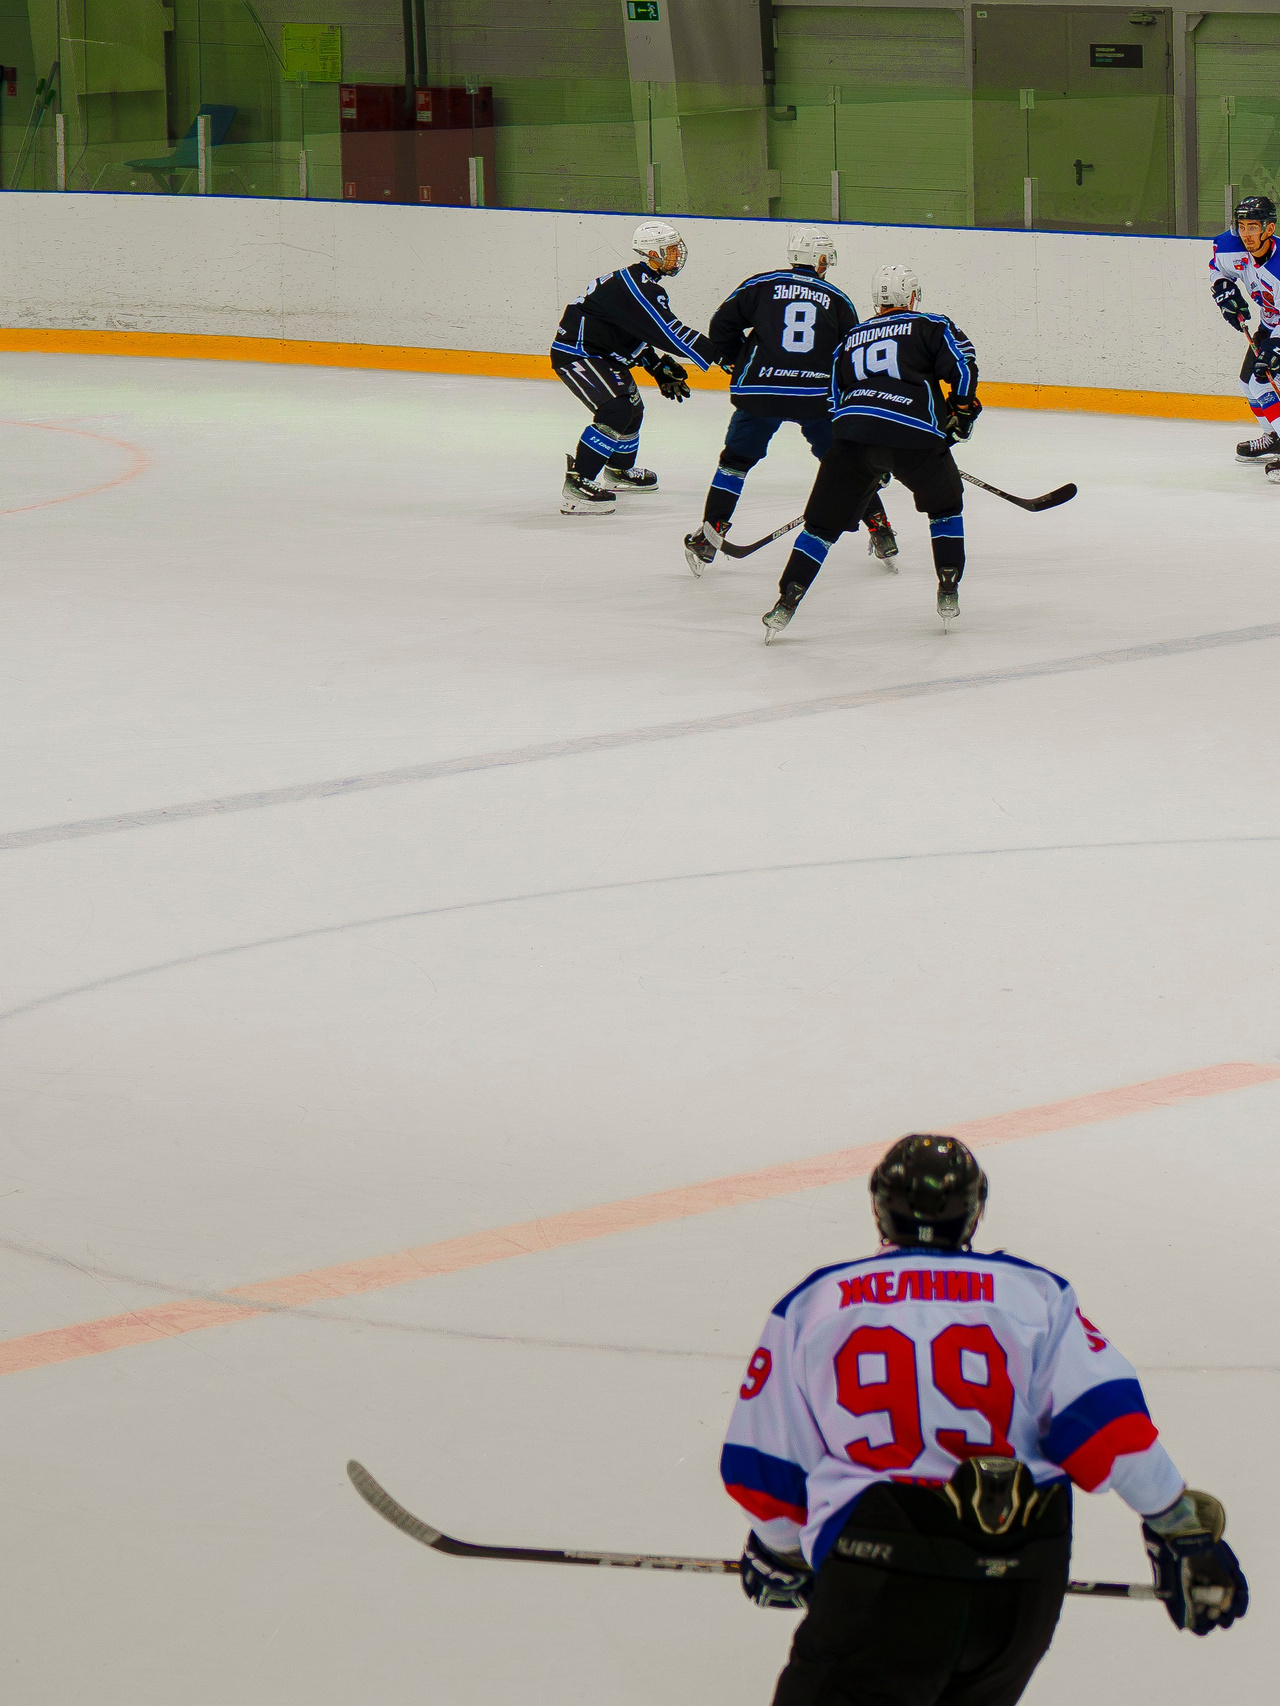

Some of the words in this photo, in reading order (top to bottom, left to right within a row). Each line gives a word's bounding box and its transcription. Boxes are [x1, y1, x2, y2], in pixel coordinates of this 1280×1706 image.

[781, 301, 818, 354] 8
[773, 369, 799, 378] ONE
[851, 339, 902, 381] 19
[851, 388, 878, 397] ONE
[877, 391, 914, 405] TIMER
[838, 1269, 994, 1309] ЖЕЛНИН
[834, 1324, 1017, 1472] 99
